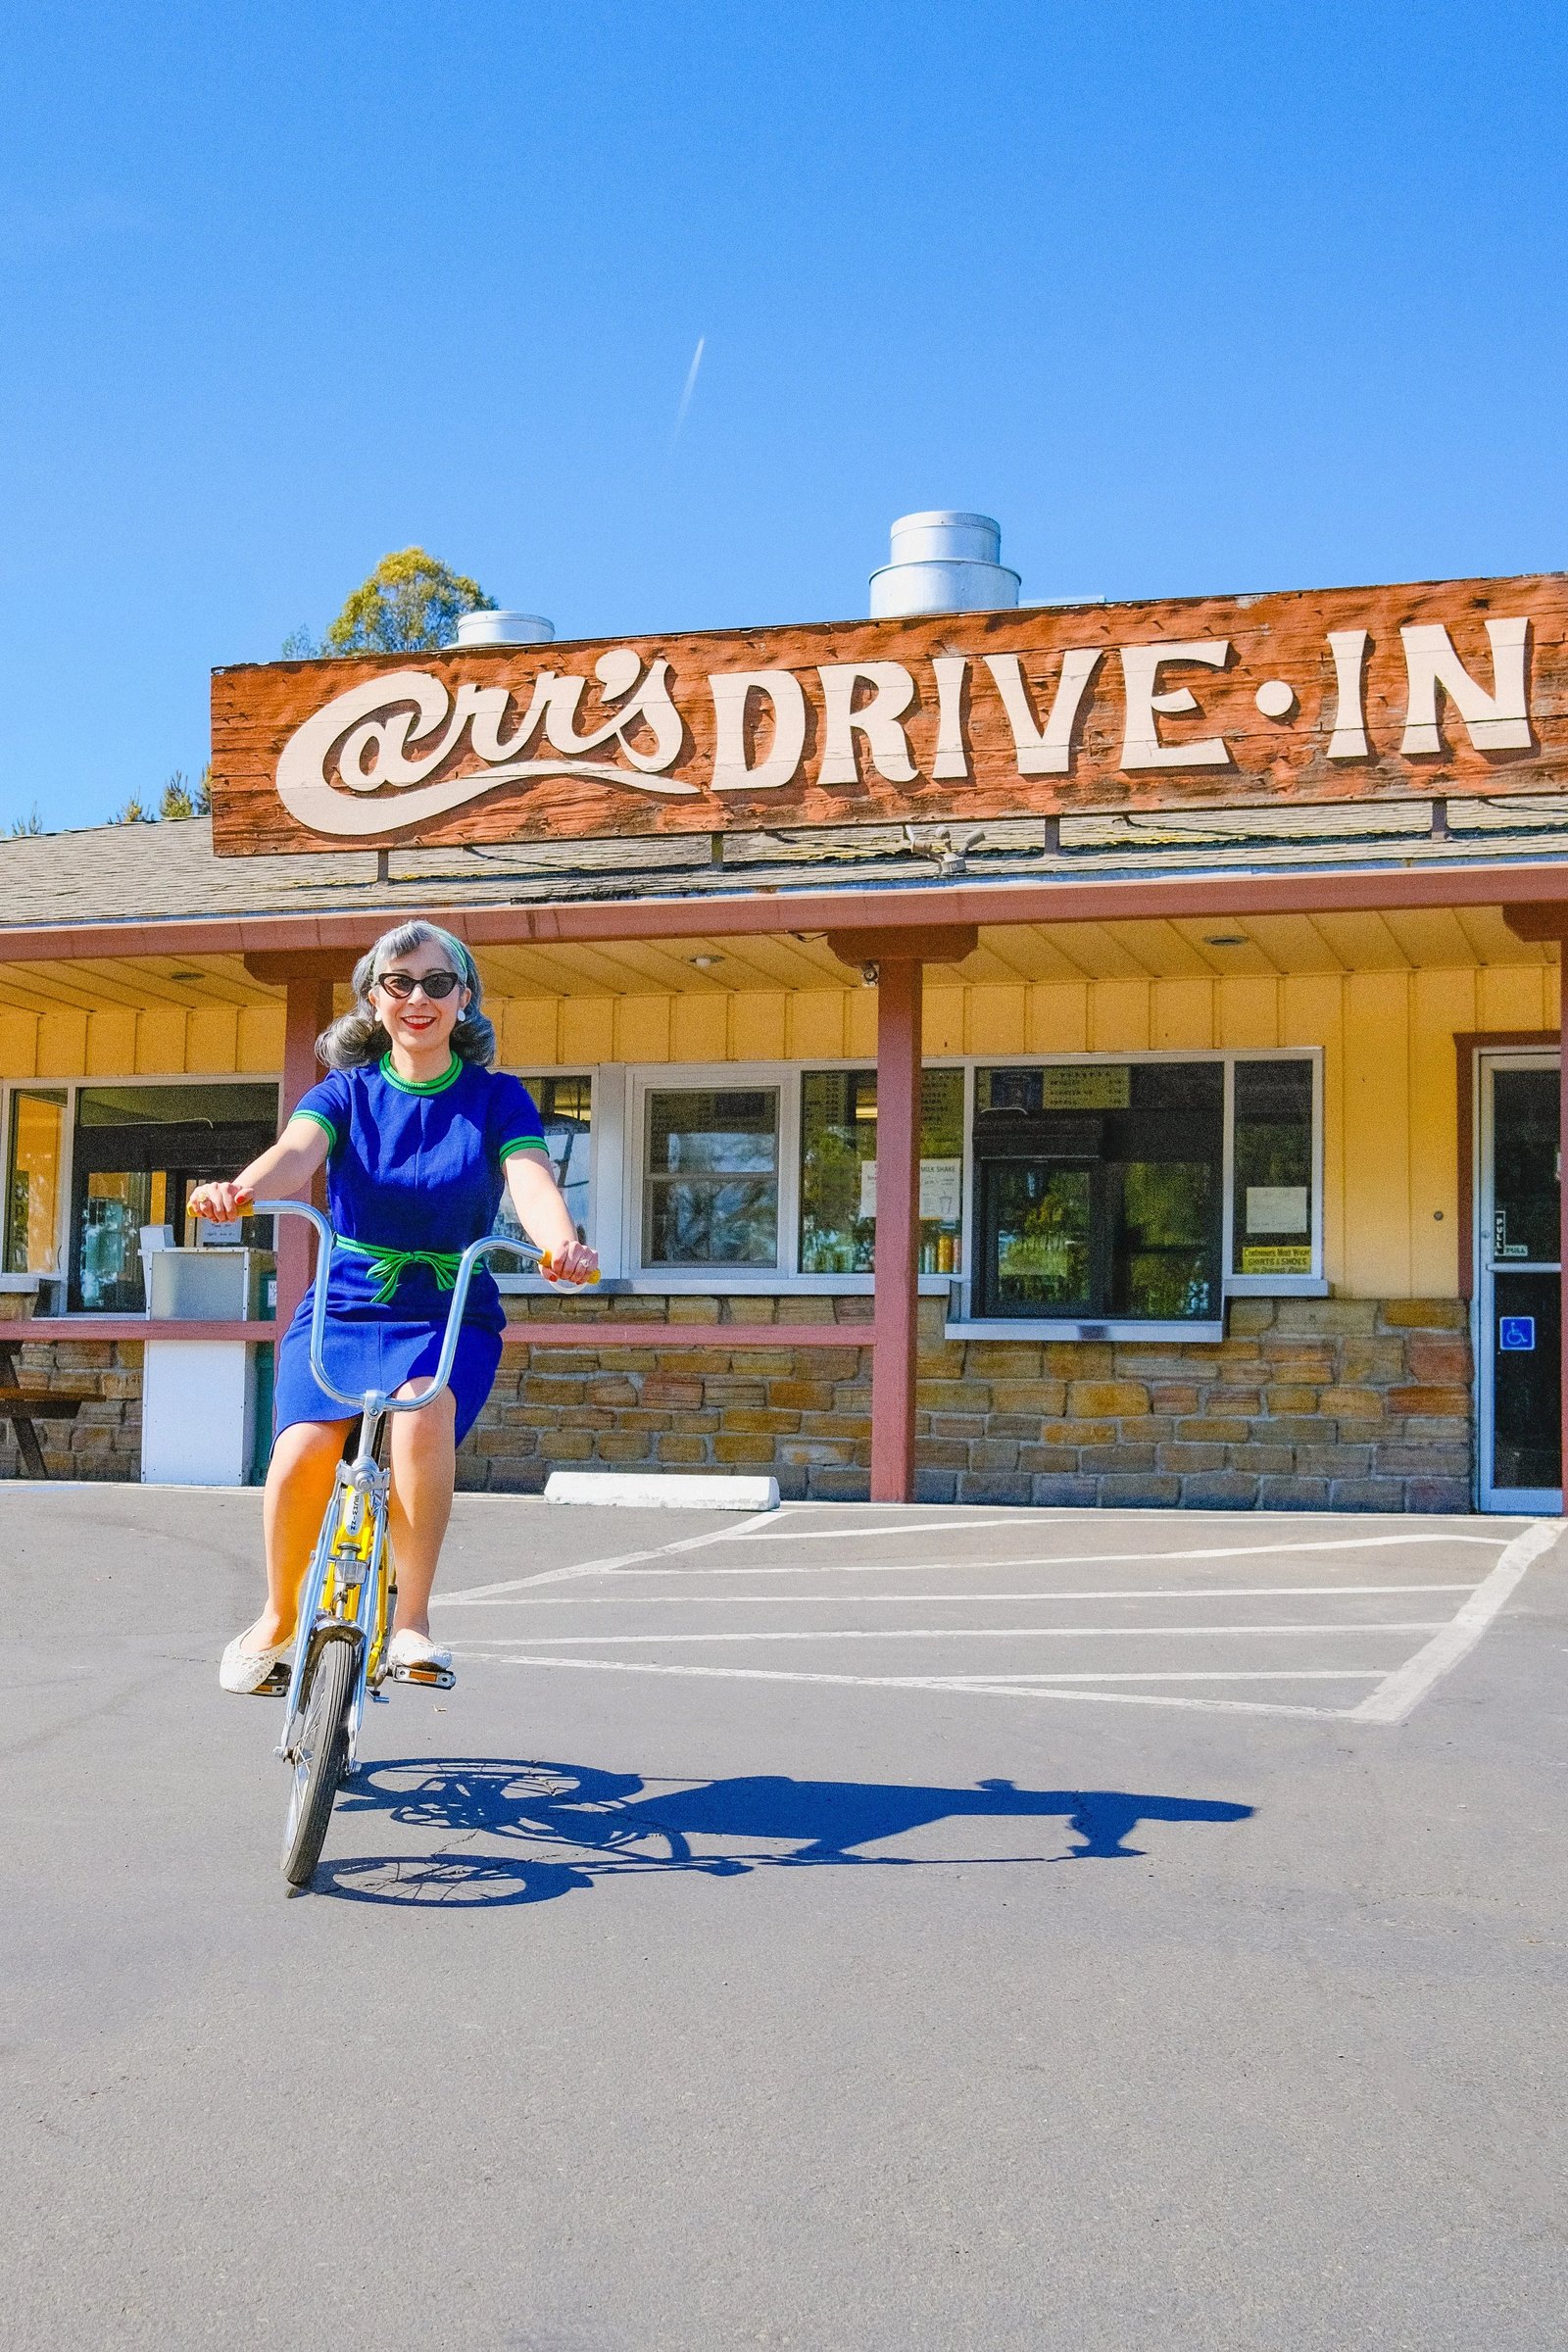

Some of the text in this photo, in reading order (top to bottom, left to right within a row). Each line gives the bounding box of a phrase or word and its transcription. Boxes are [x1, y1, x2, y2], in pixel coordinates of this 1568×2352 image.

[276, 648, 700, 836] Carr's
[1281, 1257, 1307, 1266] SHOES
[351, 1495, 360, 1530] SCHWINN
